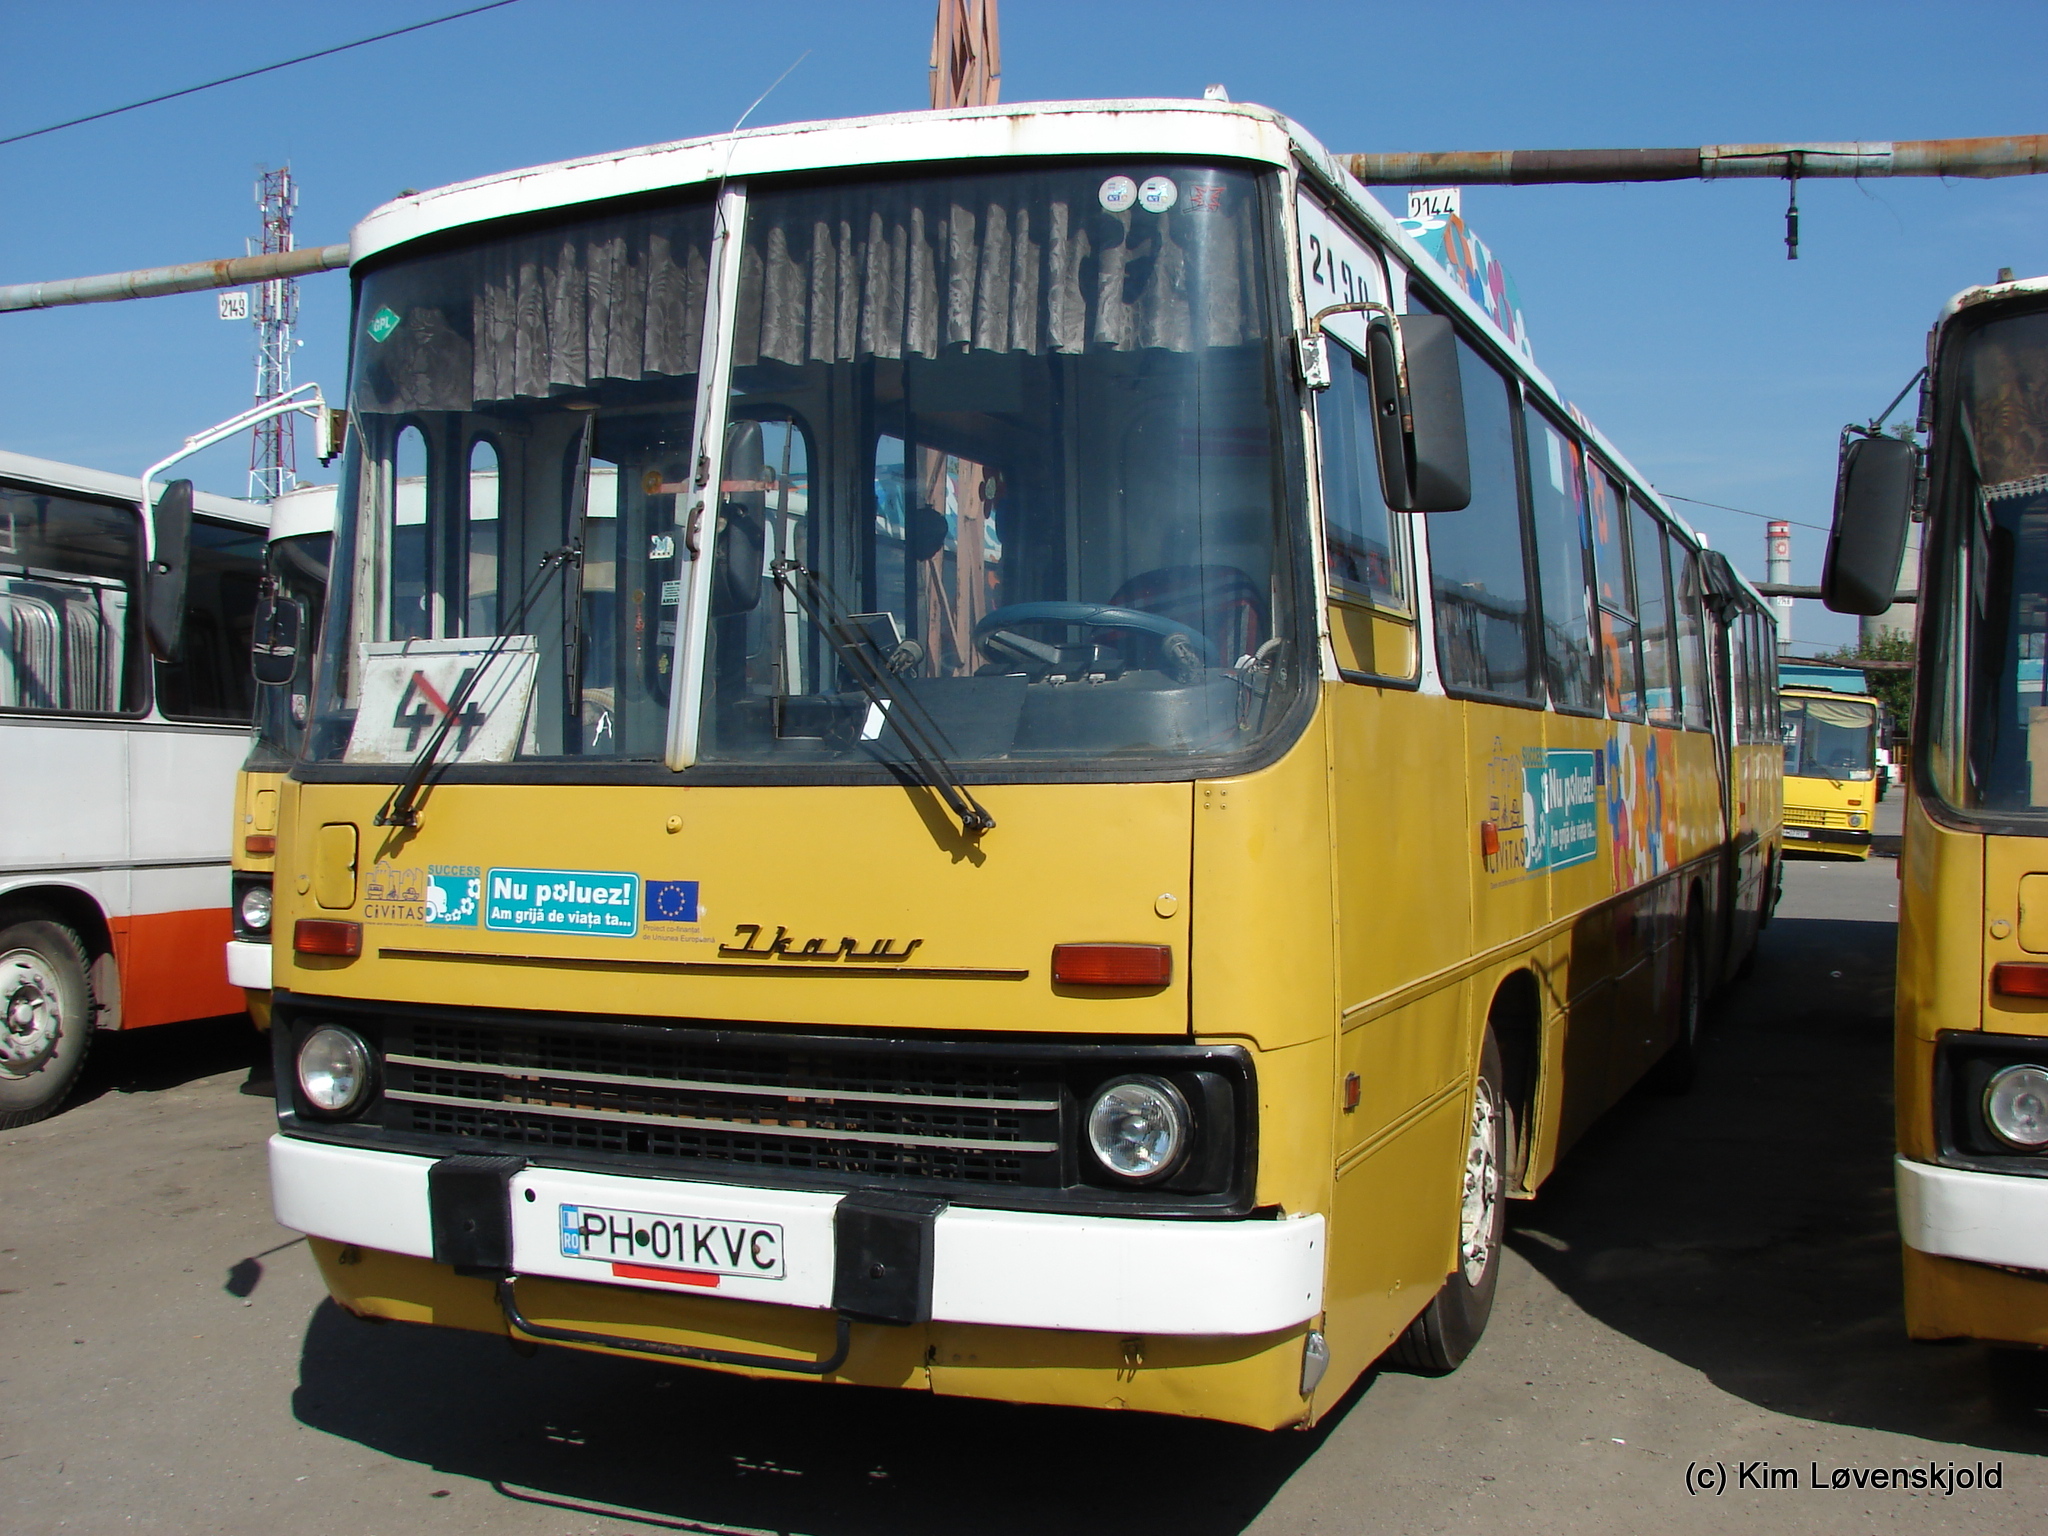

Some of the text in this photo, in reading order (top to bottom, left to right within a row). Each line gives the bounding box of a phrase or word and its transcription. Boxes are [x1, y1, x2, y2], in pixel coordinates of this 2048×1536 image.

[221, 299, 246, 317] 2143
[374, 316, 391, 332] GPL
[393, 668, 486, 751] 44
[1548, 768, 1563, 809] Nu
[428, 864, 481, 876] SUCCESS
[494, 877, 631, 907] Nu poluez!
[491, 906, 512, 920] Am
[515, 908, 545, 924] grijă
[548, 909, 565, 923] de
[605, 913, 632, 927] ta...
[643, 924, 665, 932] Proiect
[652, 934, 679, 942] Uniunea
[719, 924, 925, 958] Ikarus
[564, 1232, 579, 1248] RO
